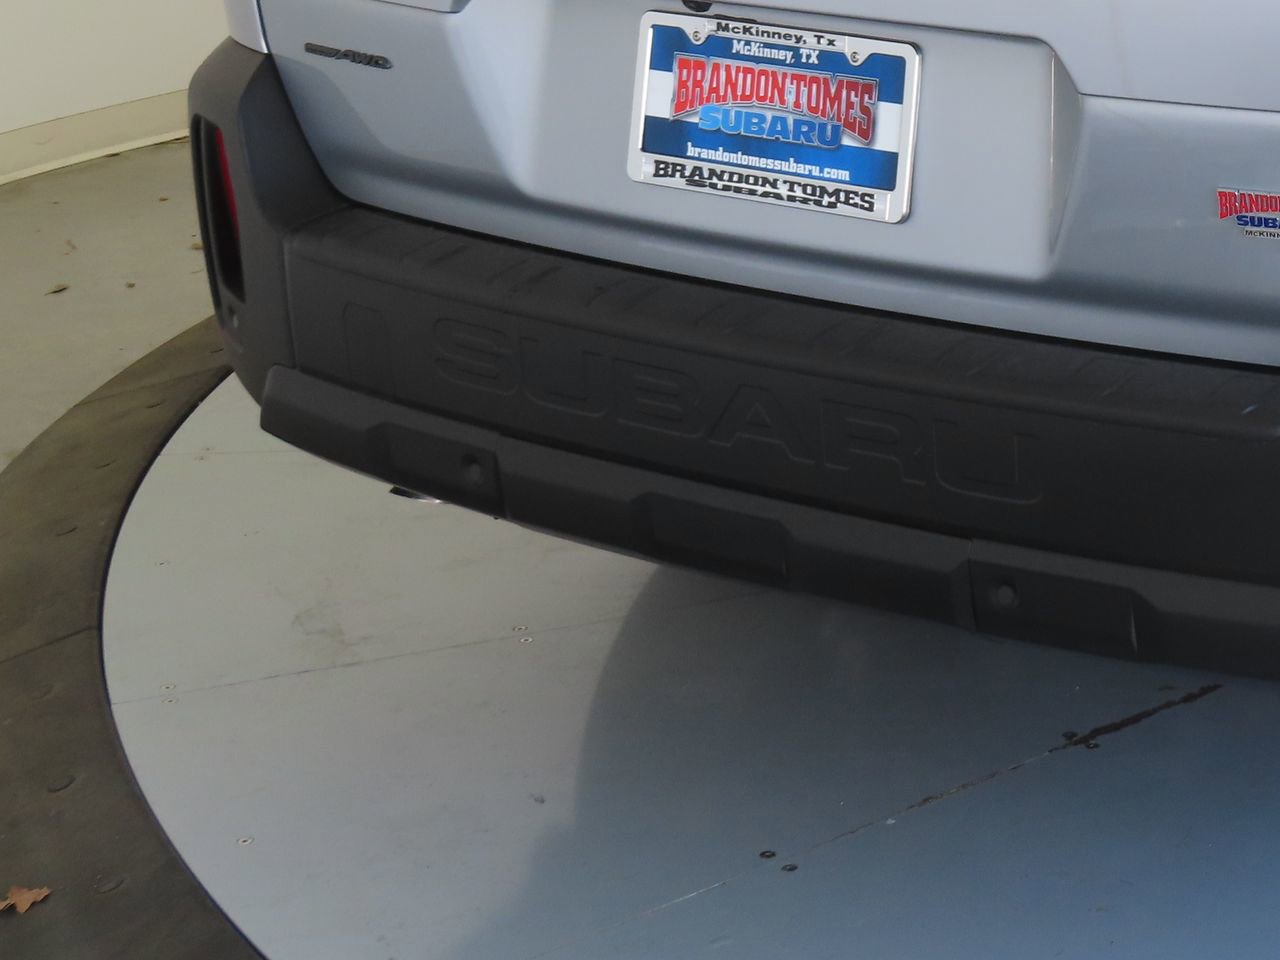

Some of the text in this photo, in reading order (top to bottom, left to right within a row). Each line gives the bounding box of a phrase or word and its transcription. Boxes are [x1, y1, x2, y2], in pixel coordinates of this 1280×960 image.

[716, 22, 837, 47] McKinney, Tx
[334, 49, 393, 70] AWD
[732, 40, 820, 65] McKinney, TX
[699, 104, 843, 148] SUBARU
[686, 142, 850, 181] brandontomessubaru.com
[653, 159, 876, 213] BRANDON TOMES
[685, 178, 841, 209] SUBARU
[432, 316, 1043, 506] SUBARU
